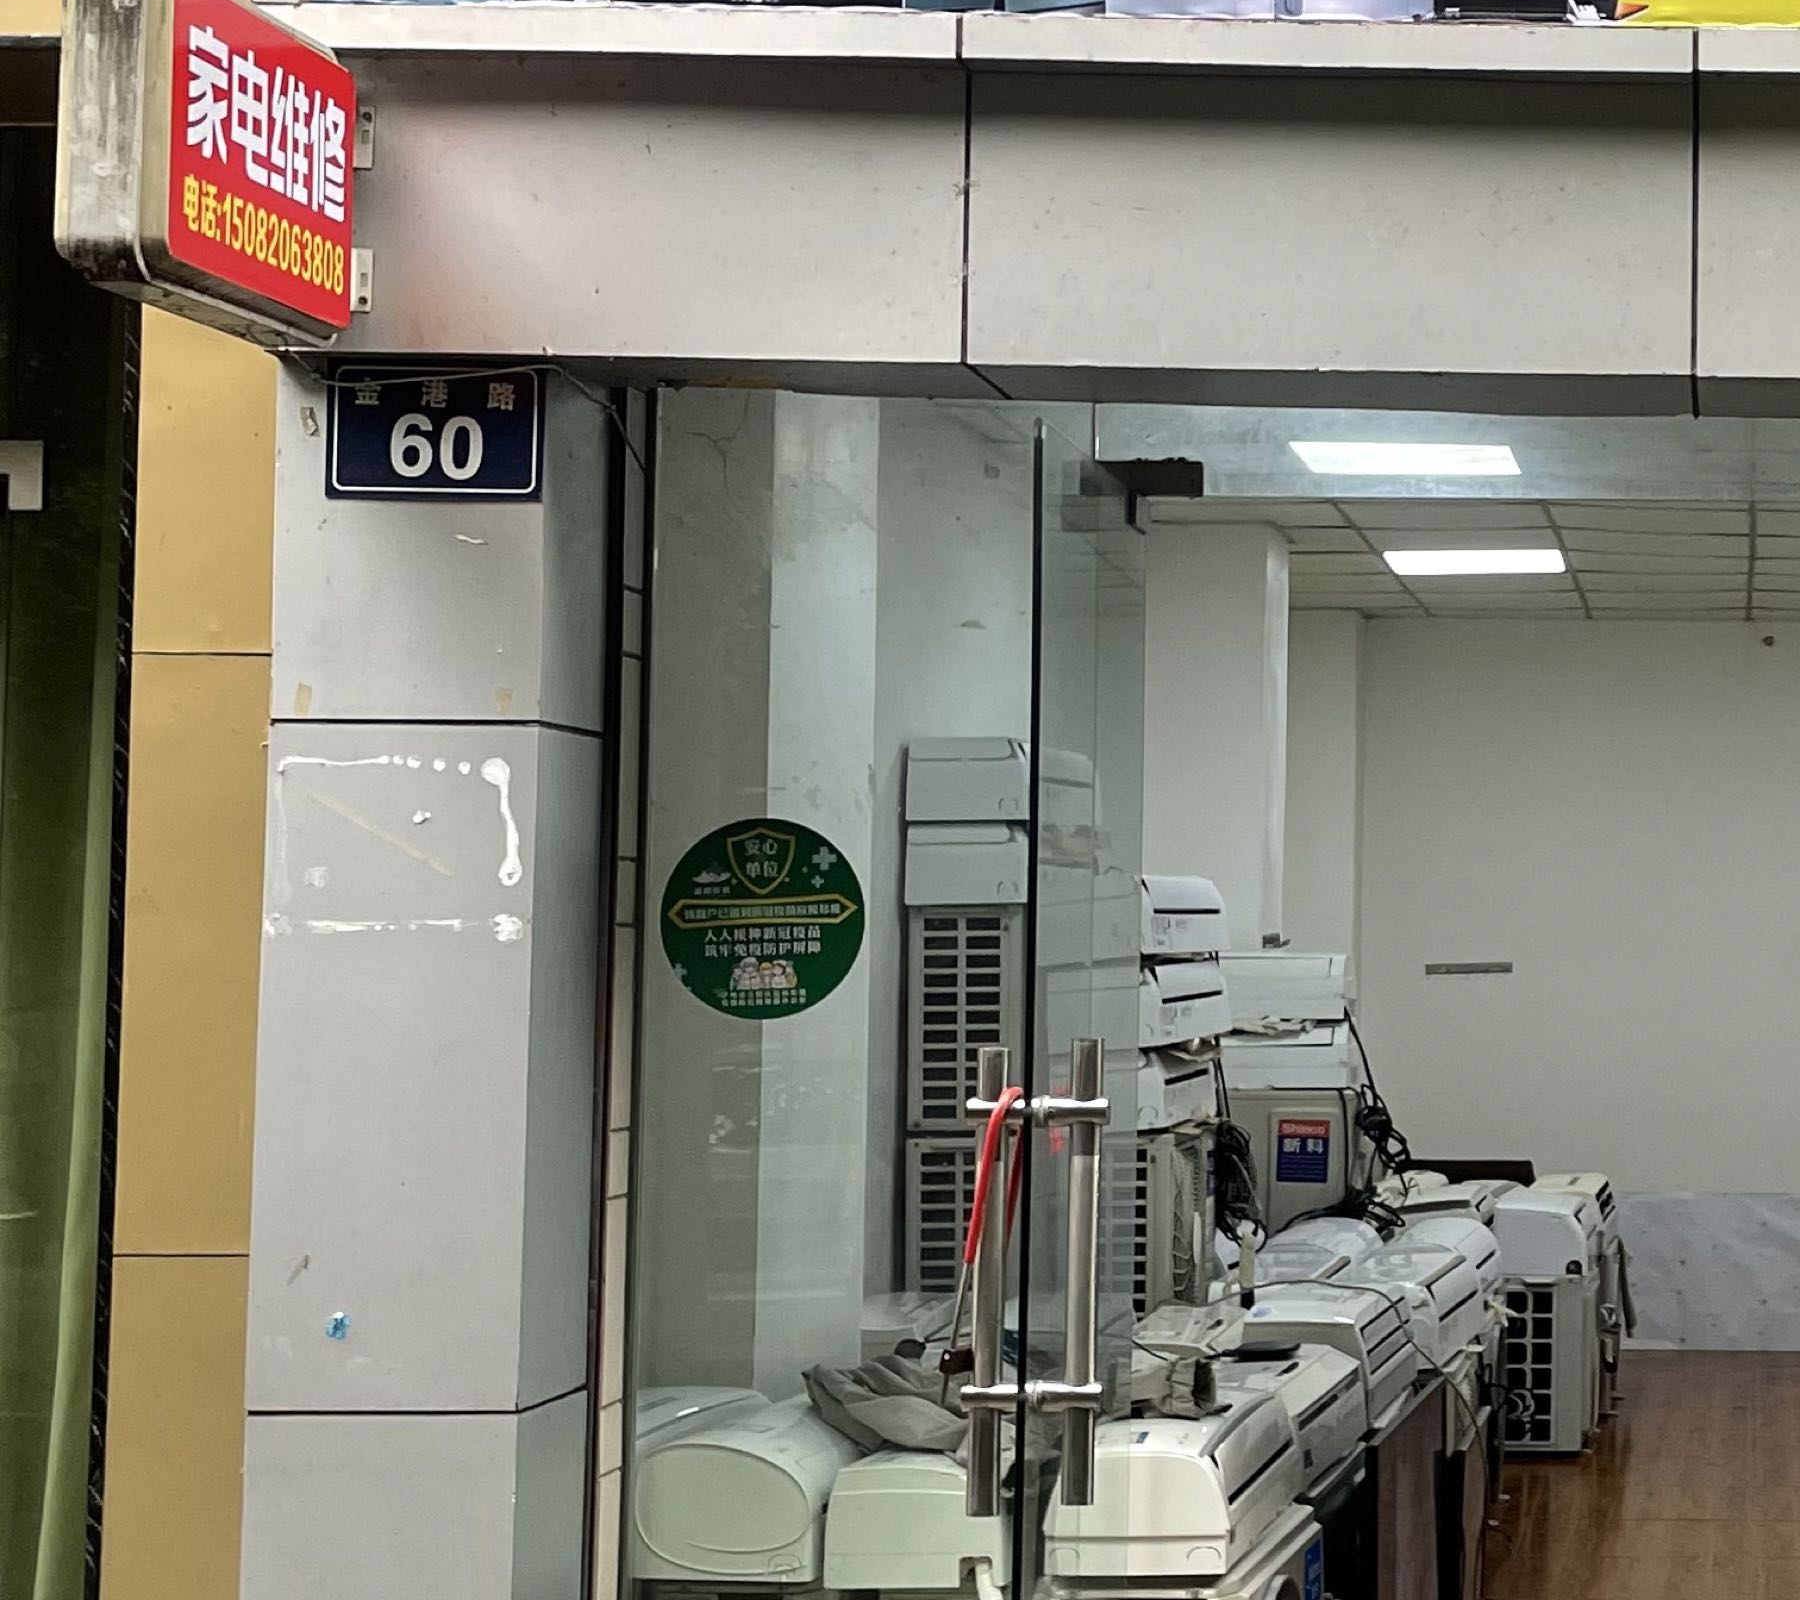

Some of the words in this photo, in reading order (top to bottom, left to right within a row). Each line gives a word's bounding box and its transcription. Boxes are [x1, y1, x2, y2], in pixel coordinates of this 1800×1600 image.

[186, 24, 346, 223] 家电维修
[182, 173, 345, 296] 电话:15082063808
[354, 376, 516, 412] 金港路
[389, 412, 484, 481] 60
